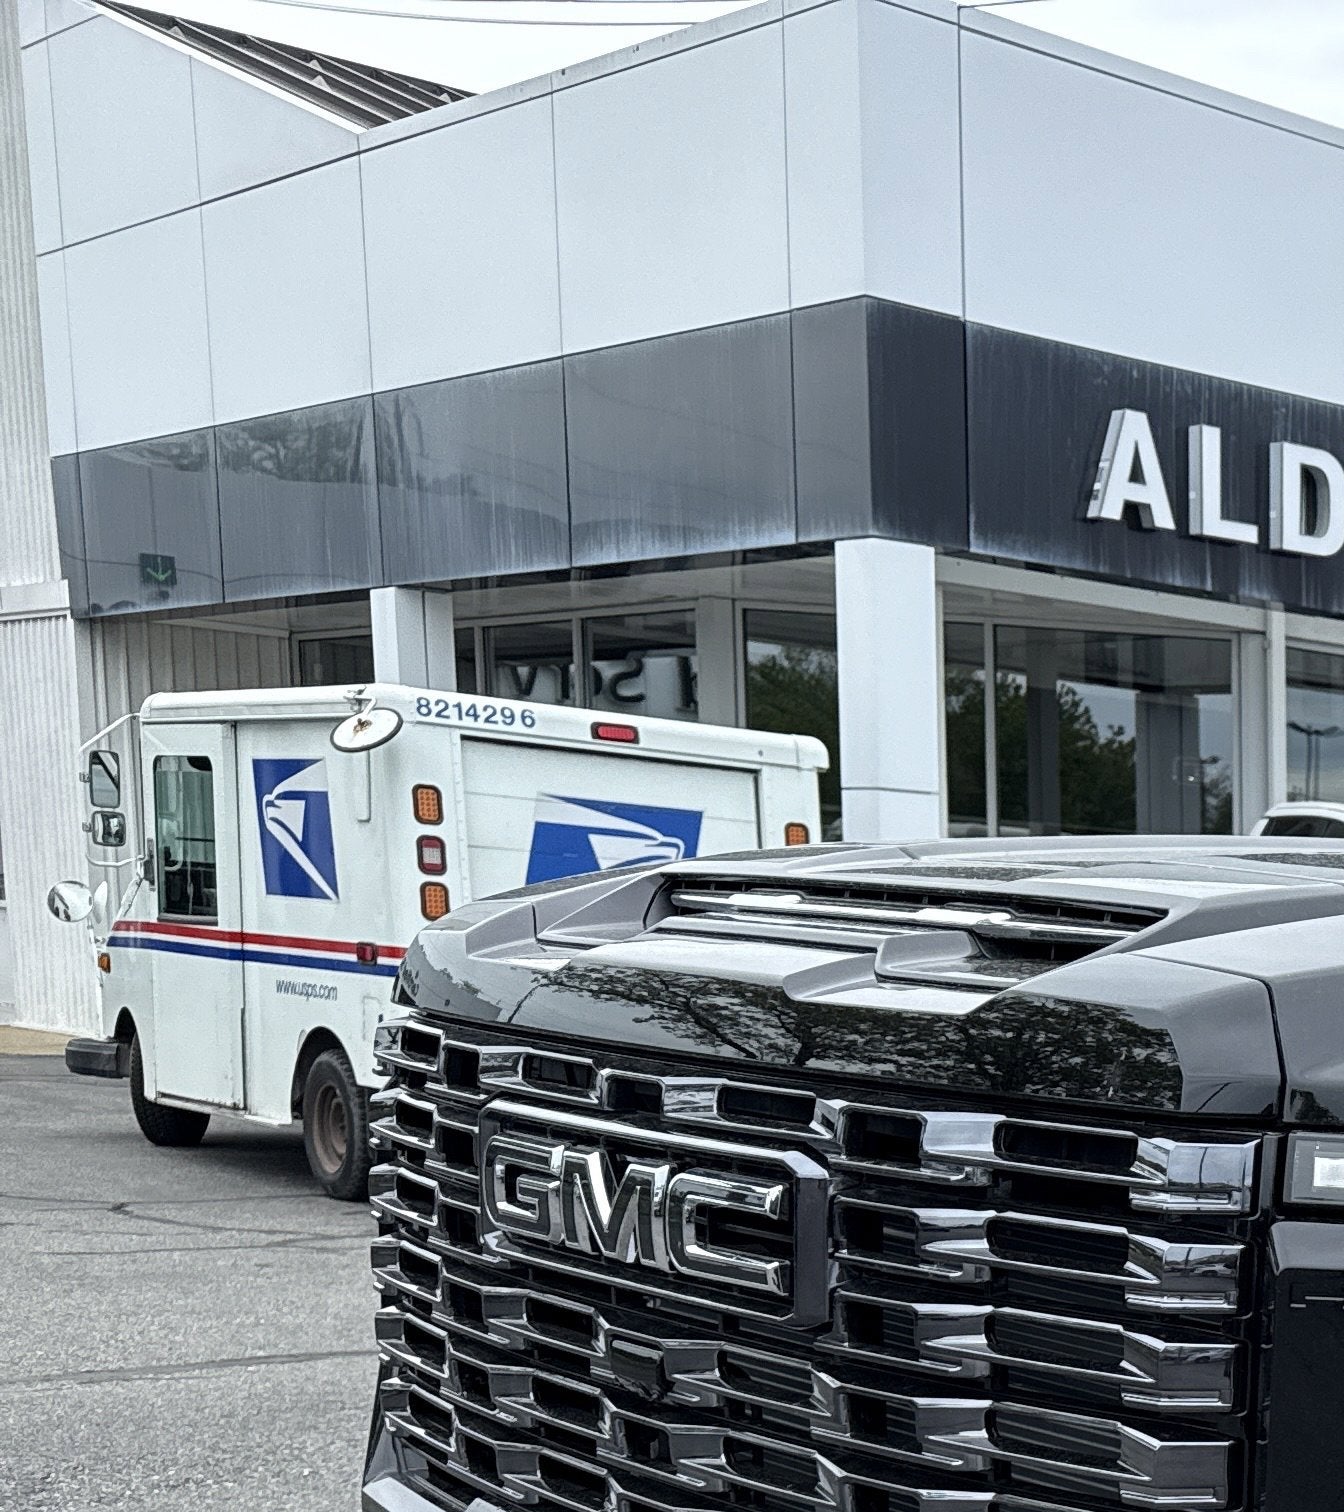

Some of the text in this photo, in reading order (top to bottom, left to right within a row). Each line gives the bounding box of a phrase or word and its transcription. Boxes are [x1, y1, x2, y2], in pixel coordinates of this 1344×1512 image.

[415, 696, 537, 729] 8214296
[275, 979, 338, 1002] www.usps.com
[482, 1134, 791, 1297] GMC
